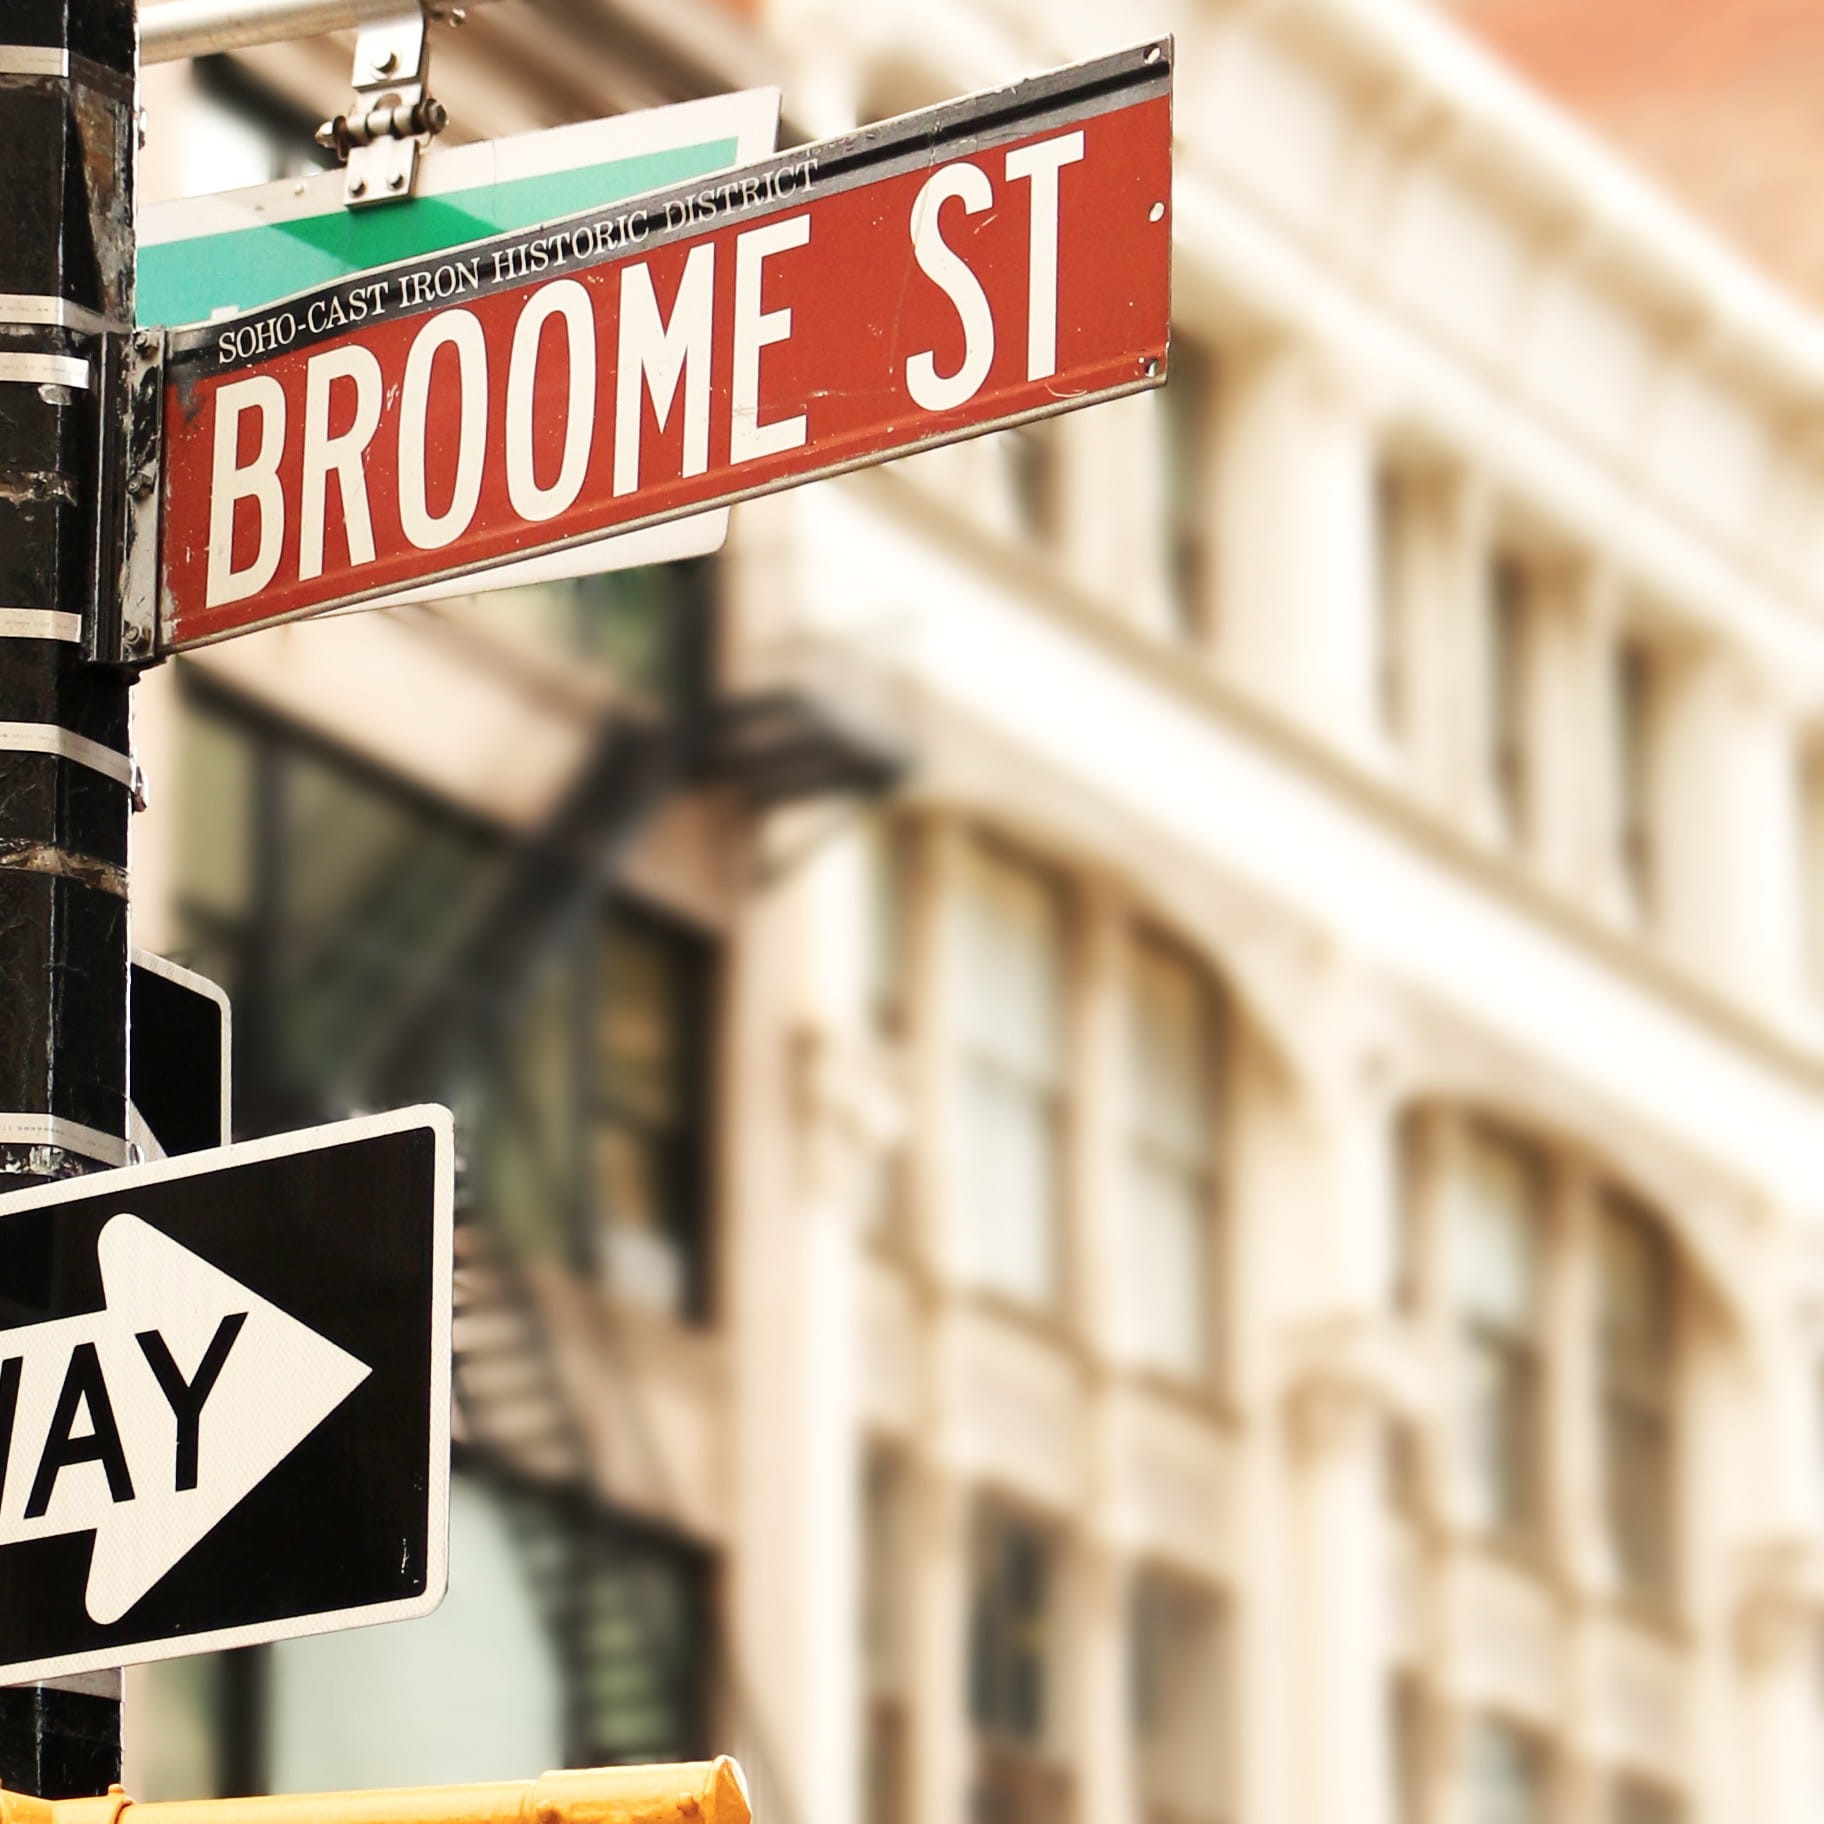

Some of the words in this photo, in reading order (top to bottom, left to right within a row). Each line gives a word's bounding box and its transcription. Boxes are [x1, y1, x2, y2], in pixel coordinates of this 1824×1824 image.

[205, 214, 810, 609] BROOME
[905, 131, 1085, 413] ST
[218, 281, 389, 364] SOHO-CAST
[398, 257, 480, 310] IRON
[492, 209, 651, 284] HISTORIC
[662, 158, 821, 234] DISTRICT
